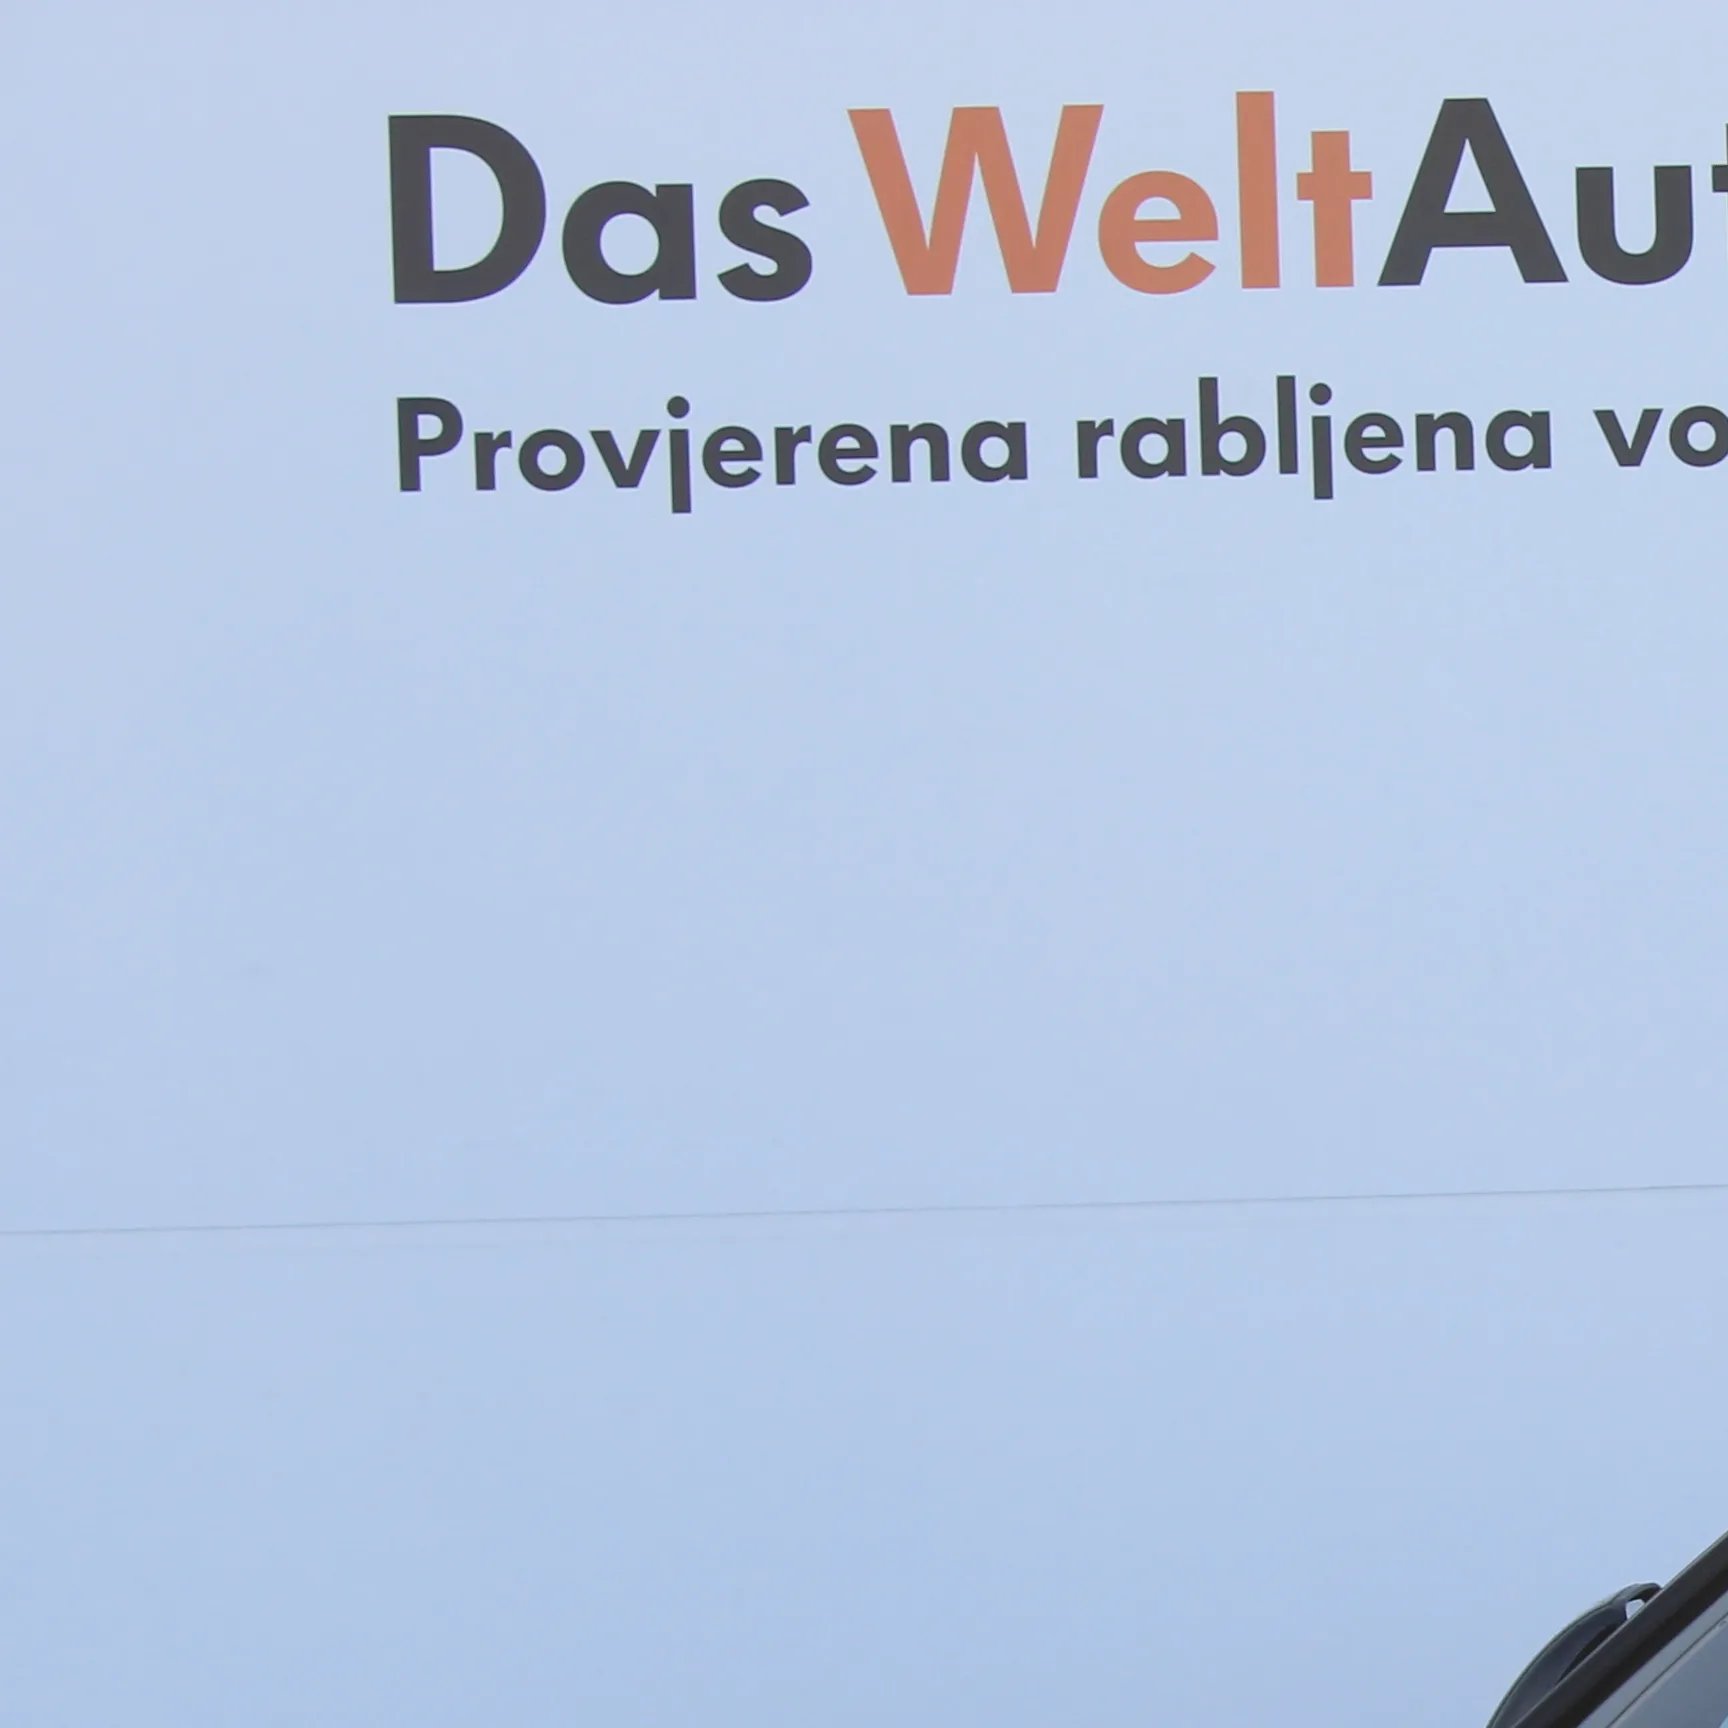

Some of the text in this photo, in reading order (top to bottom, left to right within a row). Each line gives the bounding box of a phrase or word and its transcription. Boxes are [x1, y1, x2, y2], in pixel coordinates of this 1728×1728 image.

[388, 113, 813, 306] Das
[396, 395, 1029, 514] Provjerena
[1076, 374, 1552, 501] rabljena
